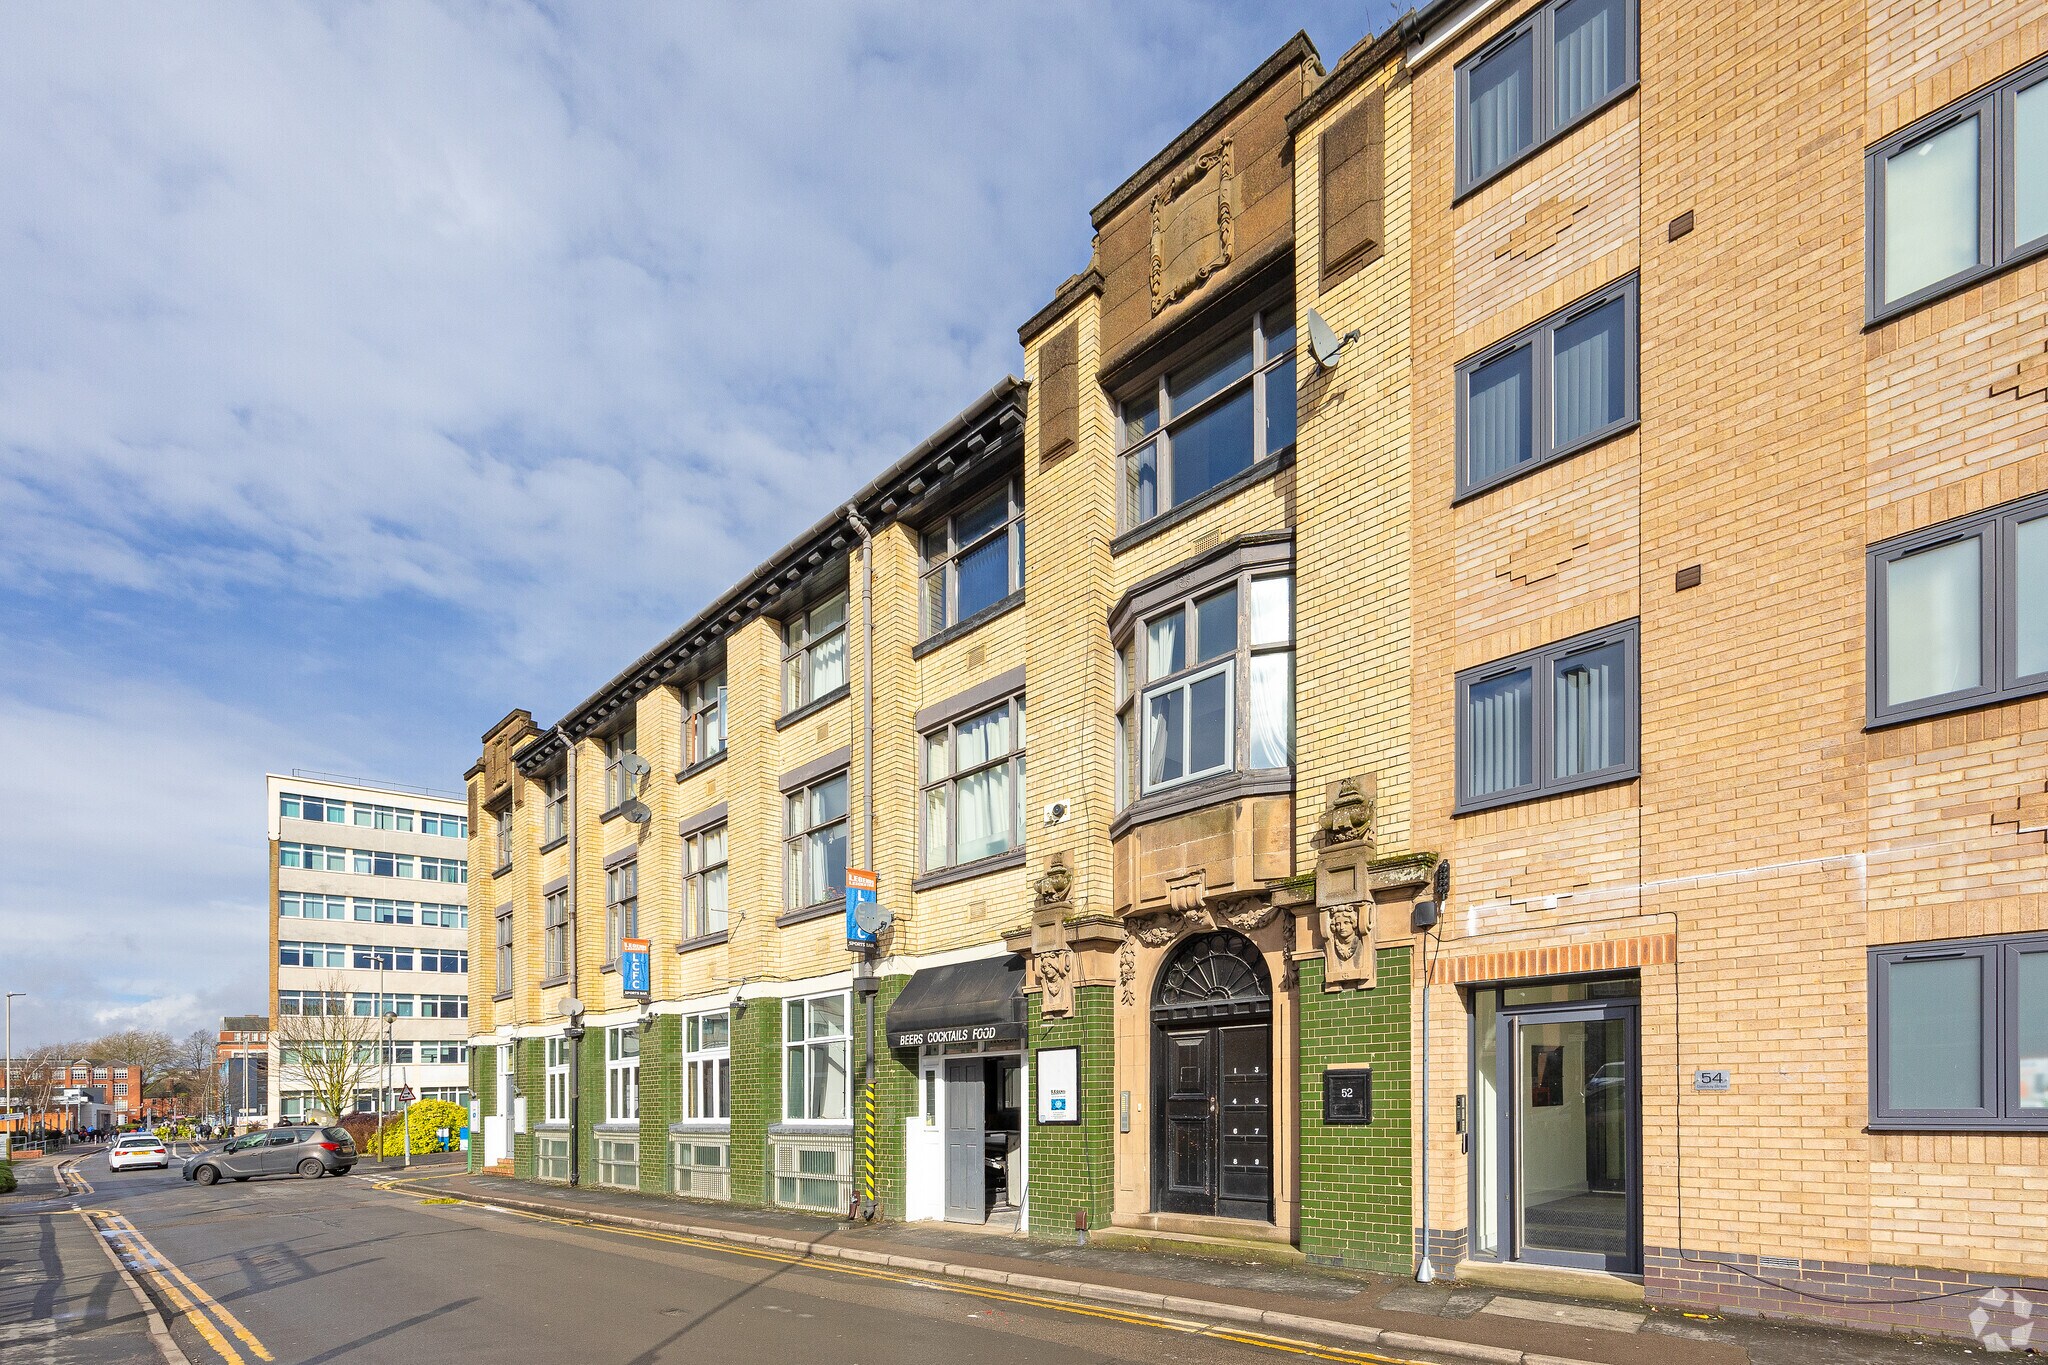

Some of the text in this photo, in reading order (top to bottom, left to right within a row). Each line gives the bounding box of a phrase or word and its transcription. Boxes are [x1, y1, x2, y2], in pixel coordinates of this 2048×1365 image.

[632, 953, 640, 989] LCFC
[899, 1026, 996, 1046] BEERS COCKTAILS FOOD
[1701, 1072, 1723, 1084] 54
[1341, 1087, 1353, 1098] 52
